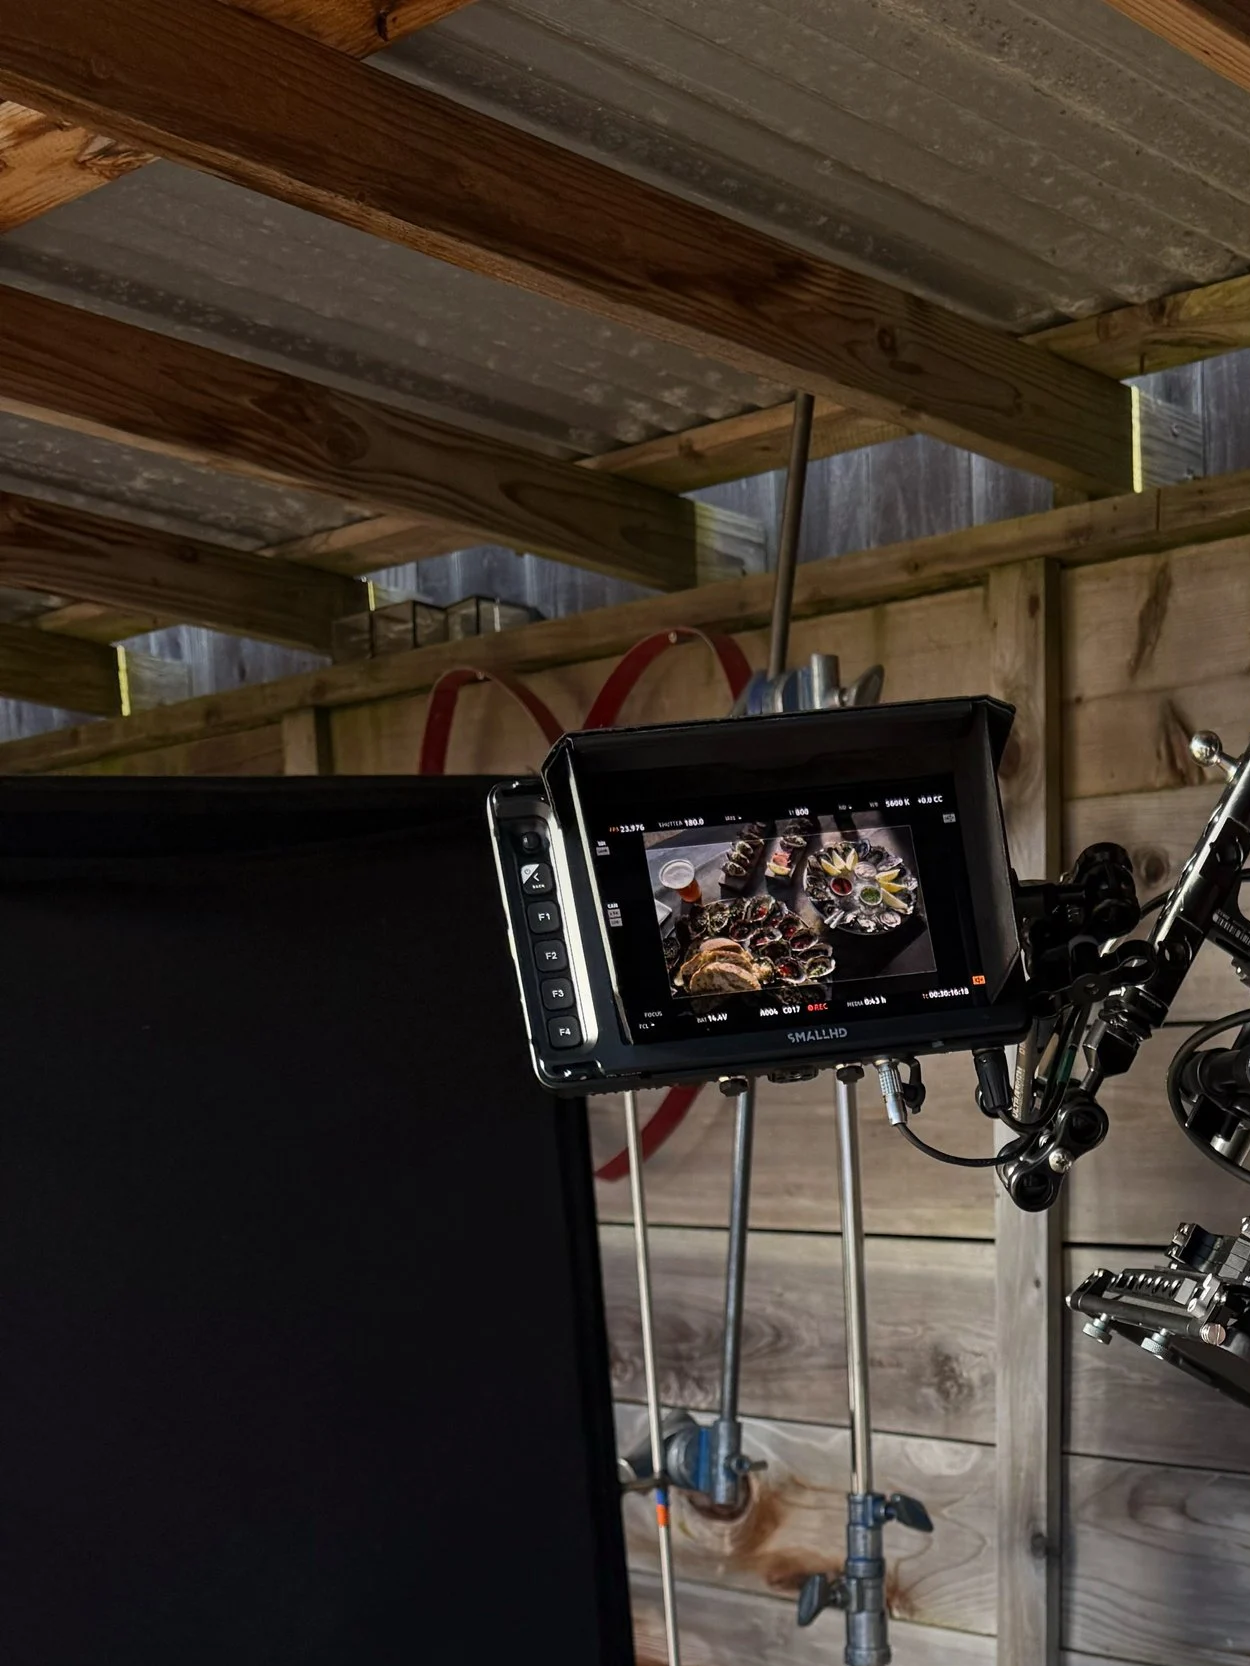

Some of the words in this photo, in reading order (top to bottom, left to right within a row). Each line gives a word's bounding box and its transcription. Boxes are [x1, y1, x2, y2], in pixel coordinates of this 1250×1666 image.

[885, 799, 903, 808] 5600
[903, 798, 911, 806] K
[933, 795, 943, 803] CC
[795, 808, 809, 816] 800
[684, 817, 704, 827] 180.0
[620, 823, 645, 833] 23.976
[538, 912, 551, 922] F1
[545, 951, 558, 961] F2
[552, 989, 565, 999] F3
[928, 987, 970, 999] 00:30:16:18
[814, 1003, 829, 1011] REC
[846, 1000, 864, 1008] MEDIA
[864, 996, 880, 1006] 0:43
[644, 1010, 663, 1018] FOCUS
[759, 1007, 779, 1017] A004
[782, 1005, 800, 1015] C017
[558, 1027, 572, 1037] F4
[787, 1027, 848, 1044] SMALLHD
